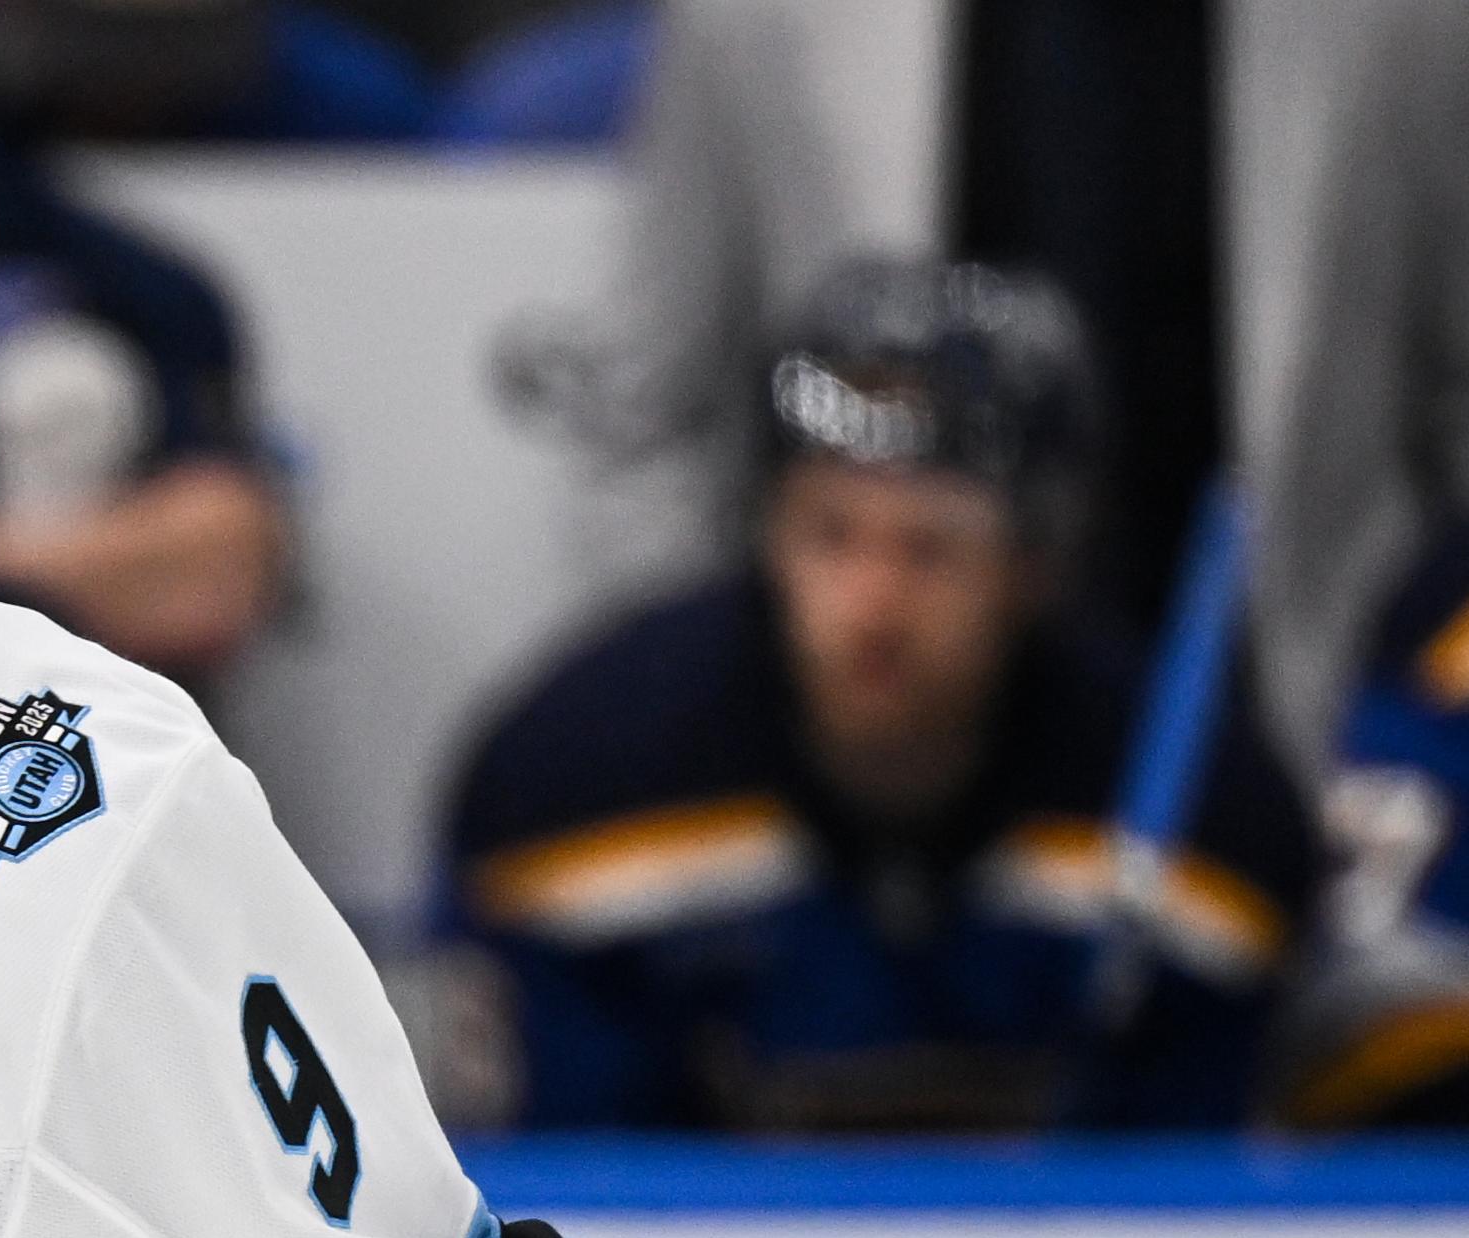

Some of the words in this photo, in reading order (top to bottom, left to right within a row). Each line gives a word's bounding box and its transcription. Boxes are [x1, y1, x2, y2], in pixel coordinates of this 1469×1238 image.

[15, 700, 55, 737] 2025
[9, 751, 66, 809] UTAH
[239, 973, 362, 1229] 9
